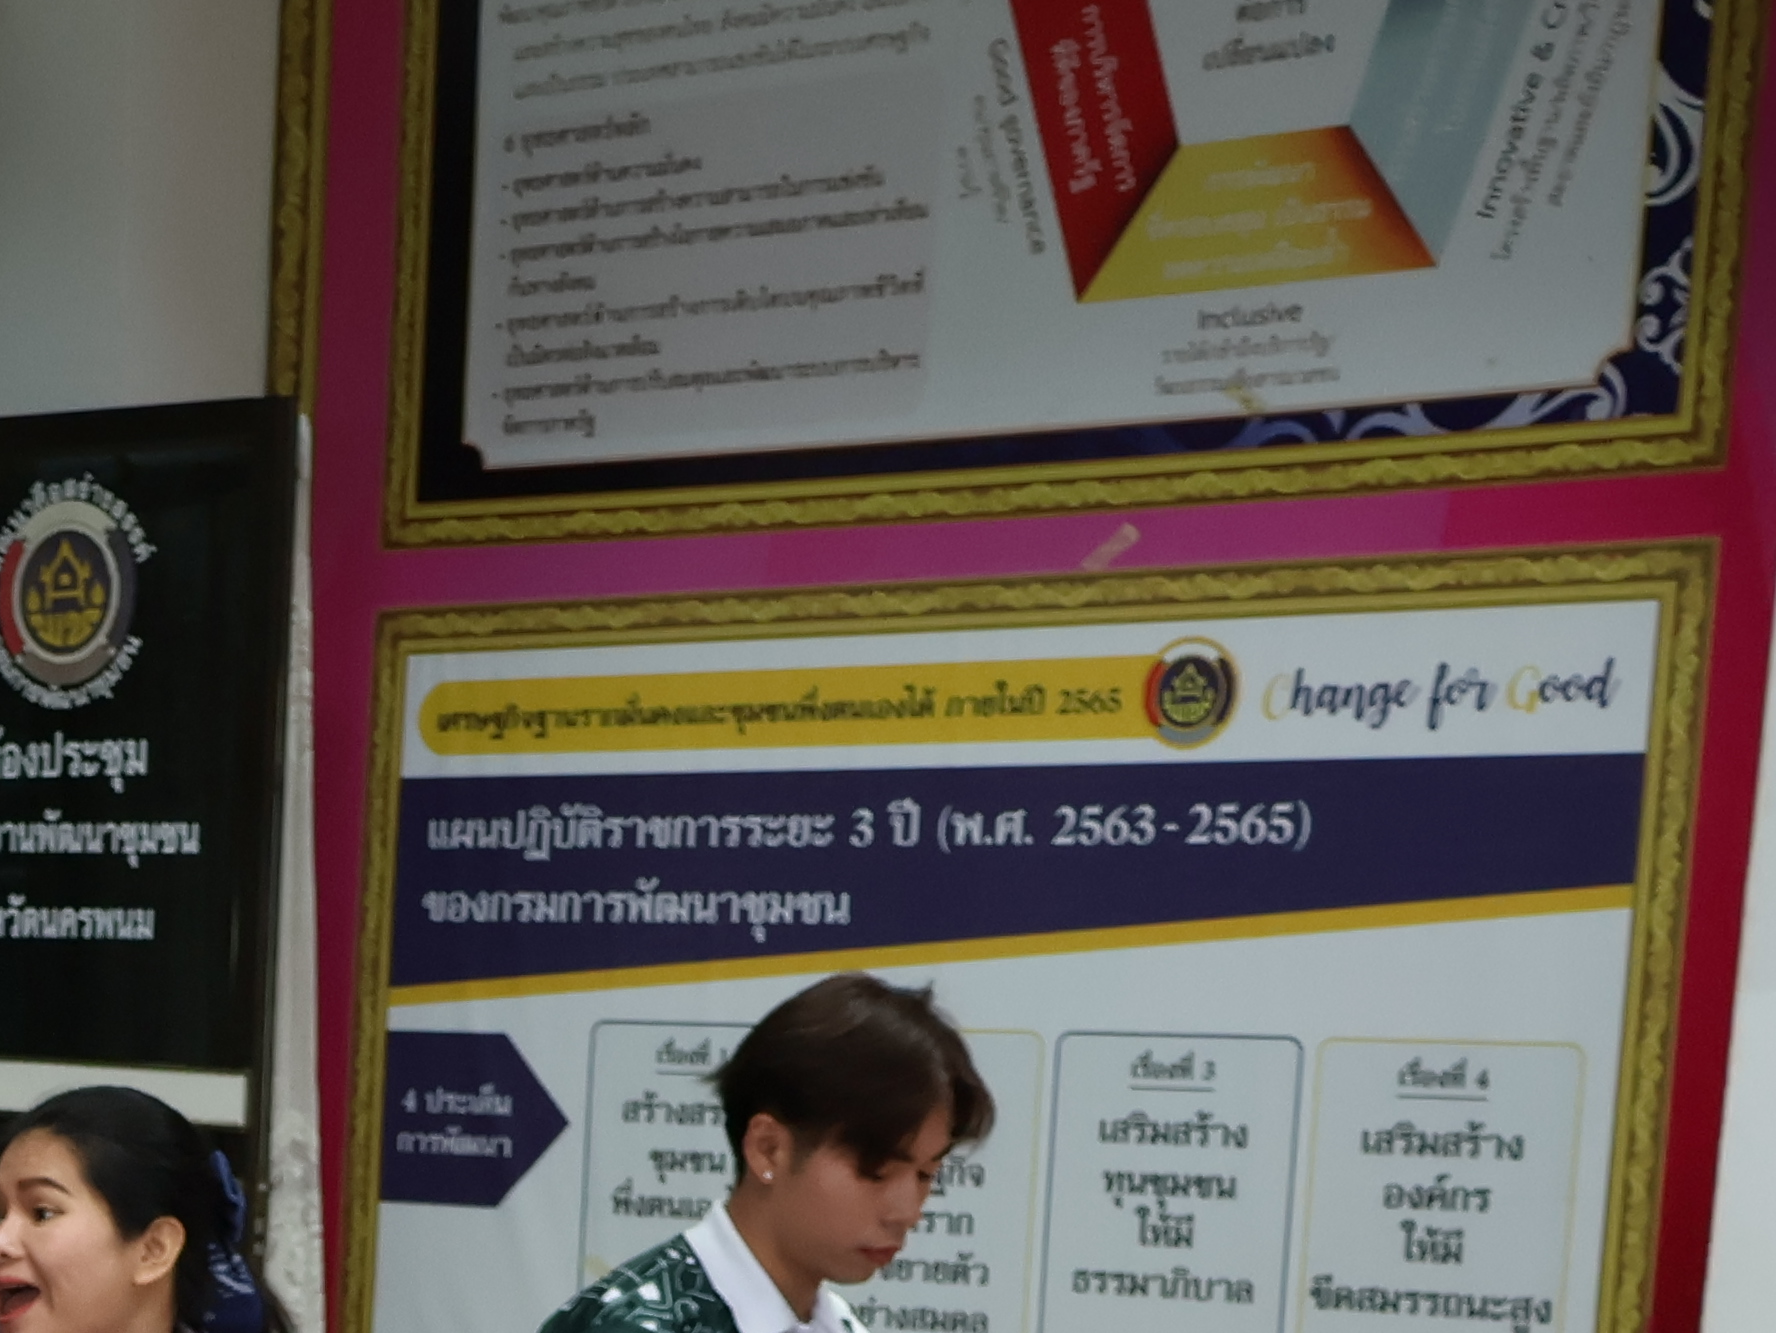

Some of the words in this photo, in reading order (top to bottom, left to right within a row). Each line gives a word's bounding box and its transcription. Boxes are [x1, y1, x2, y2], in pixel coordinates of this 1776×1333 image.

[1057, 685, 1122, 715] 2565
[1262, 666, 1410, 722] Change
[1427, 662, 1488, 730] for
[1506, 657, 1616, 715] Good
[427, 801, 835, 861] แผนปฏิบัติราชการระยะ
[849, 808, 875, 847] 3
[890, 797, 921, 846] ปี
[421, 876, 850, 943] ของกรมการพัฒนาชุมชน
[1098, 1111, 1249, 1151] เสริมสร้าง
[1361, 1122, 1525, 1162] เสริมสร้าง
[1104, 1166, 1236, 1212] ทุนชุมชน
[1383, 1175, 1491, 1213] องค์กร
[1137, 1207, 1194, 1249] ให้มี
[1403, 1221, 1464, 1265] ให้มี
[1072, 1266, 1254, 1306] ธรรมาภิบาล
